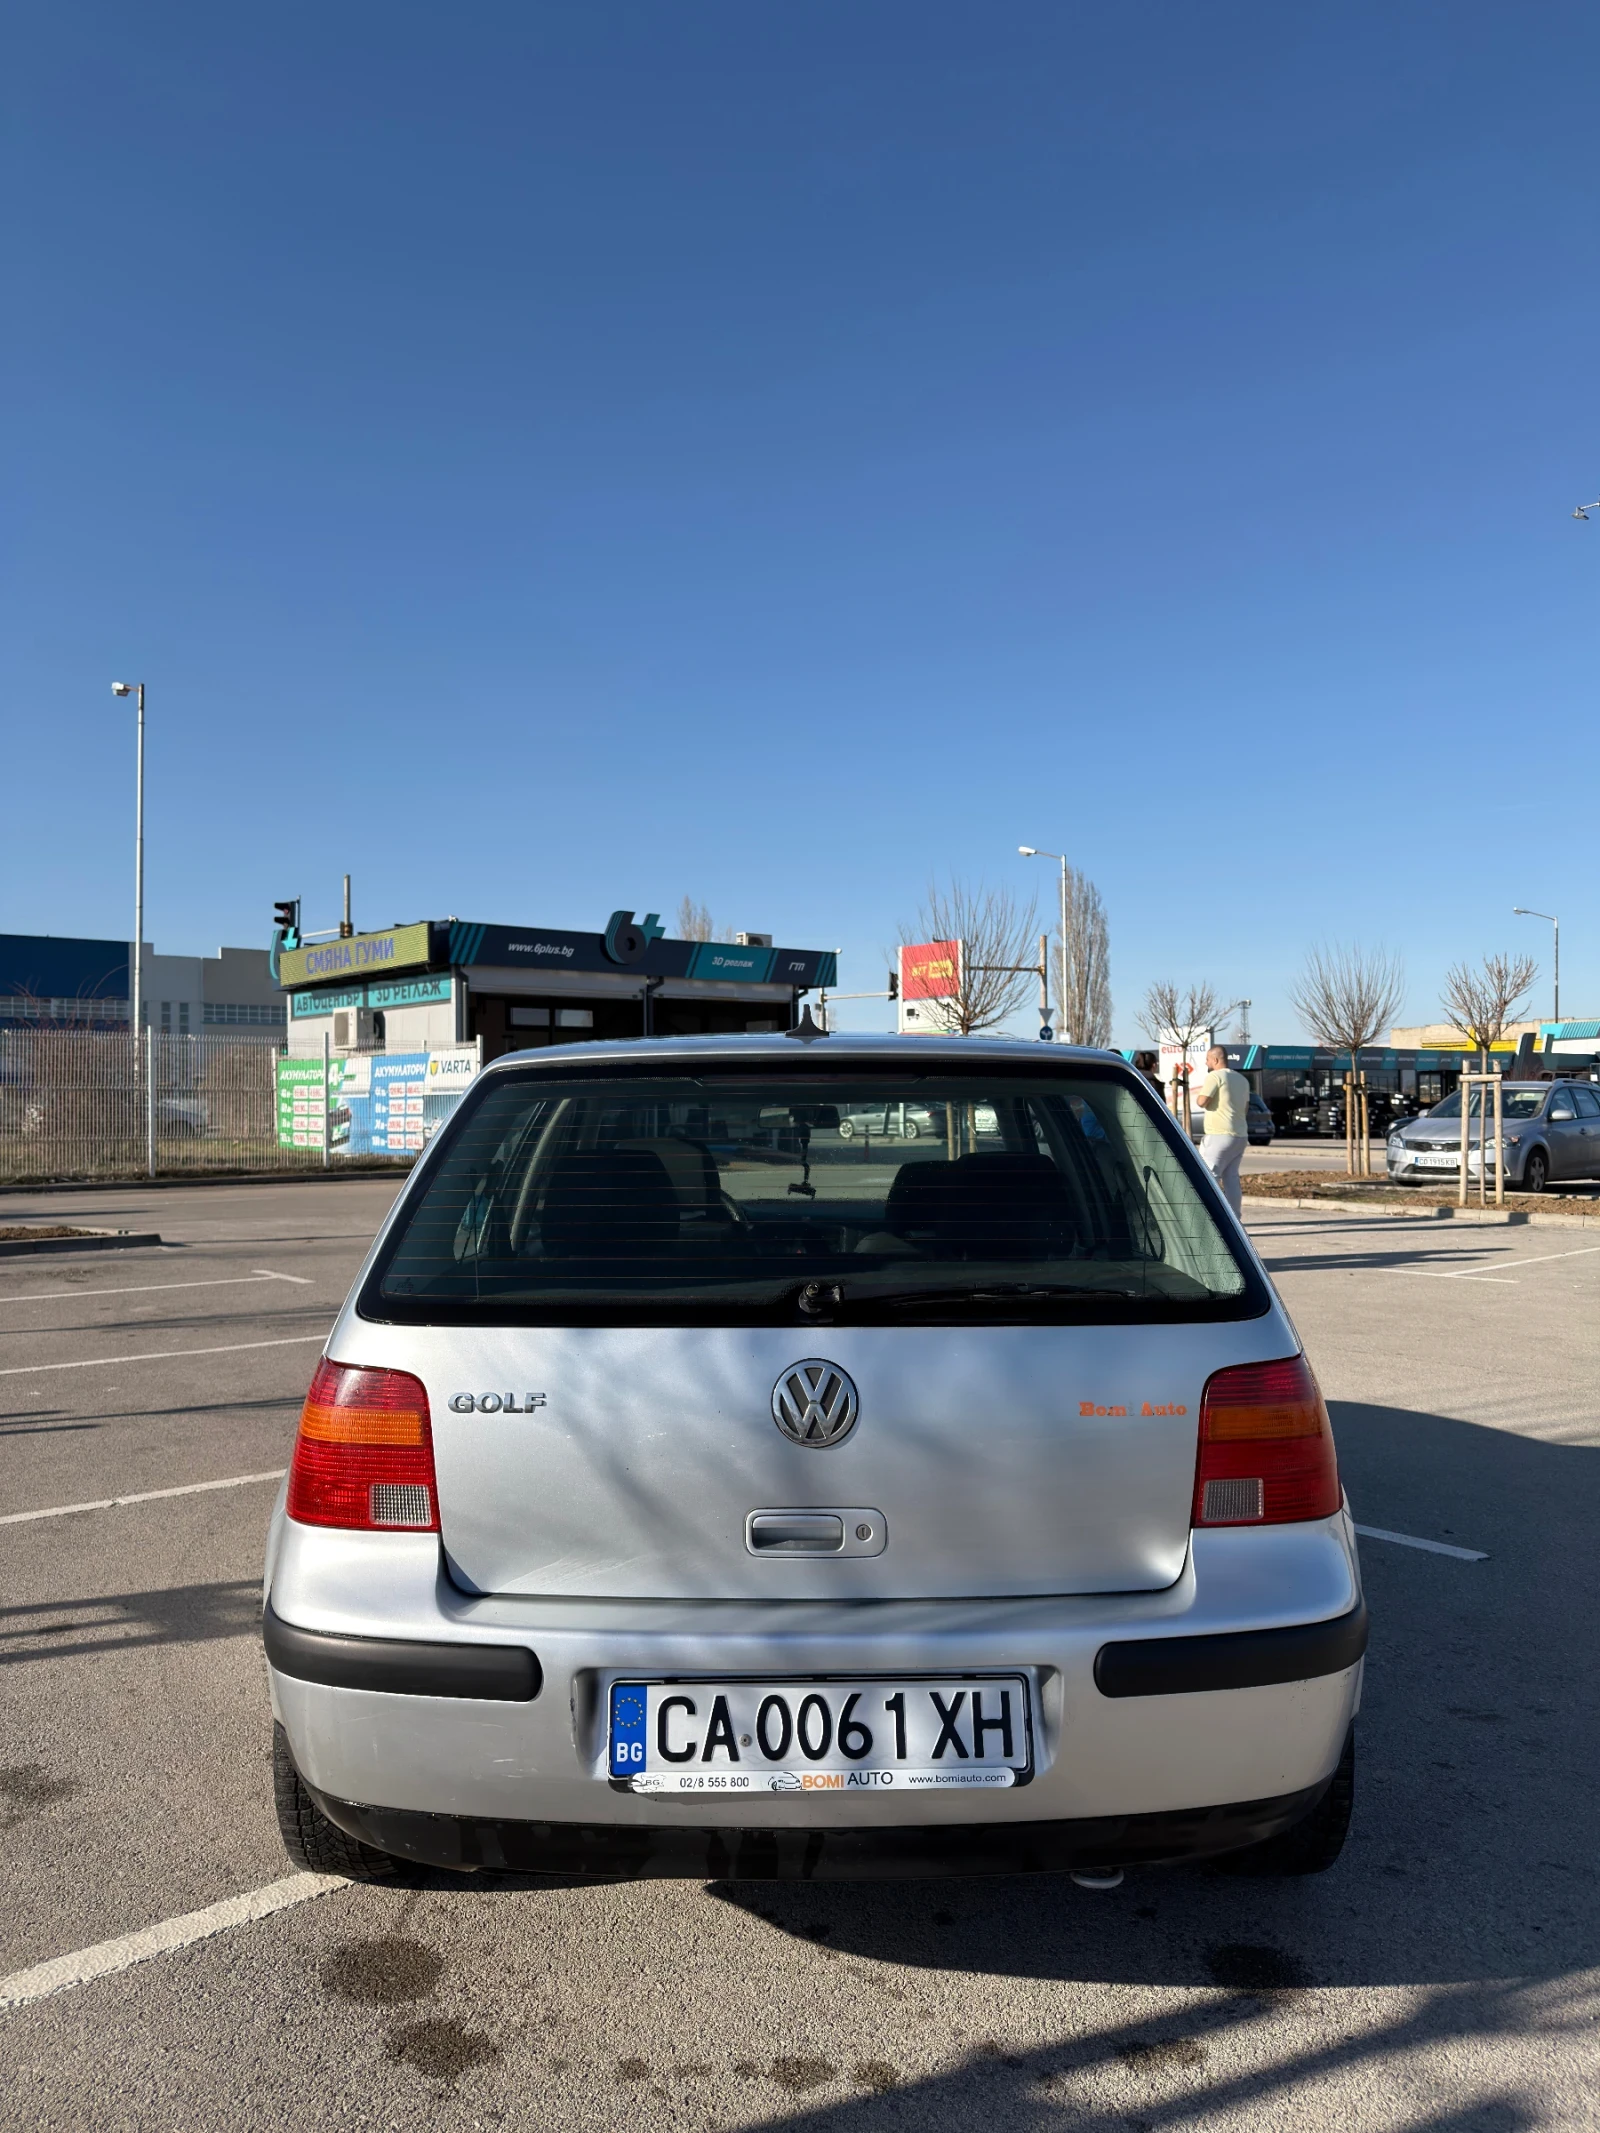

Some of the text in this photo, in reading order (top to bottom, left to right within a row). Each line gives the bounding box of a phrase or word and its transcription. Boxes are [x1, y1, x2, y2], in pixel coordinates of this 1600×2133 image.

[305, 938, 395, 975] СМЯНА ГУМИ
[508, 942, 575, 957] www.6plus.bg
[712, 956, 724, 966] 3D
[376, 979, 441, 1002] 3D РЕГЛАЖ
[1161, 1042, 1206, 1054] euroand
[374, 1063, 426, 1078] АКУМУЛАТОРИ
[441, 1059, 471, 1074] VARTA
[447, 1392, 547, 1413] GOLF
[1141, 1401, 1187, 1416] Auto
[656, 1690, 1014, 1763] CA 0061 XH
[616, 1743, 643, 1762] BG
[679, 1777, 750, 1788] 02/8 555 800
[802, 1772, 893, 1789] BOMI AUTO
[908, 1774, 1006, 1783] www.bomiauto.com
